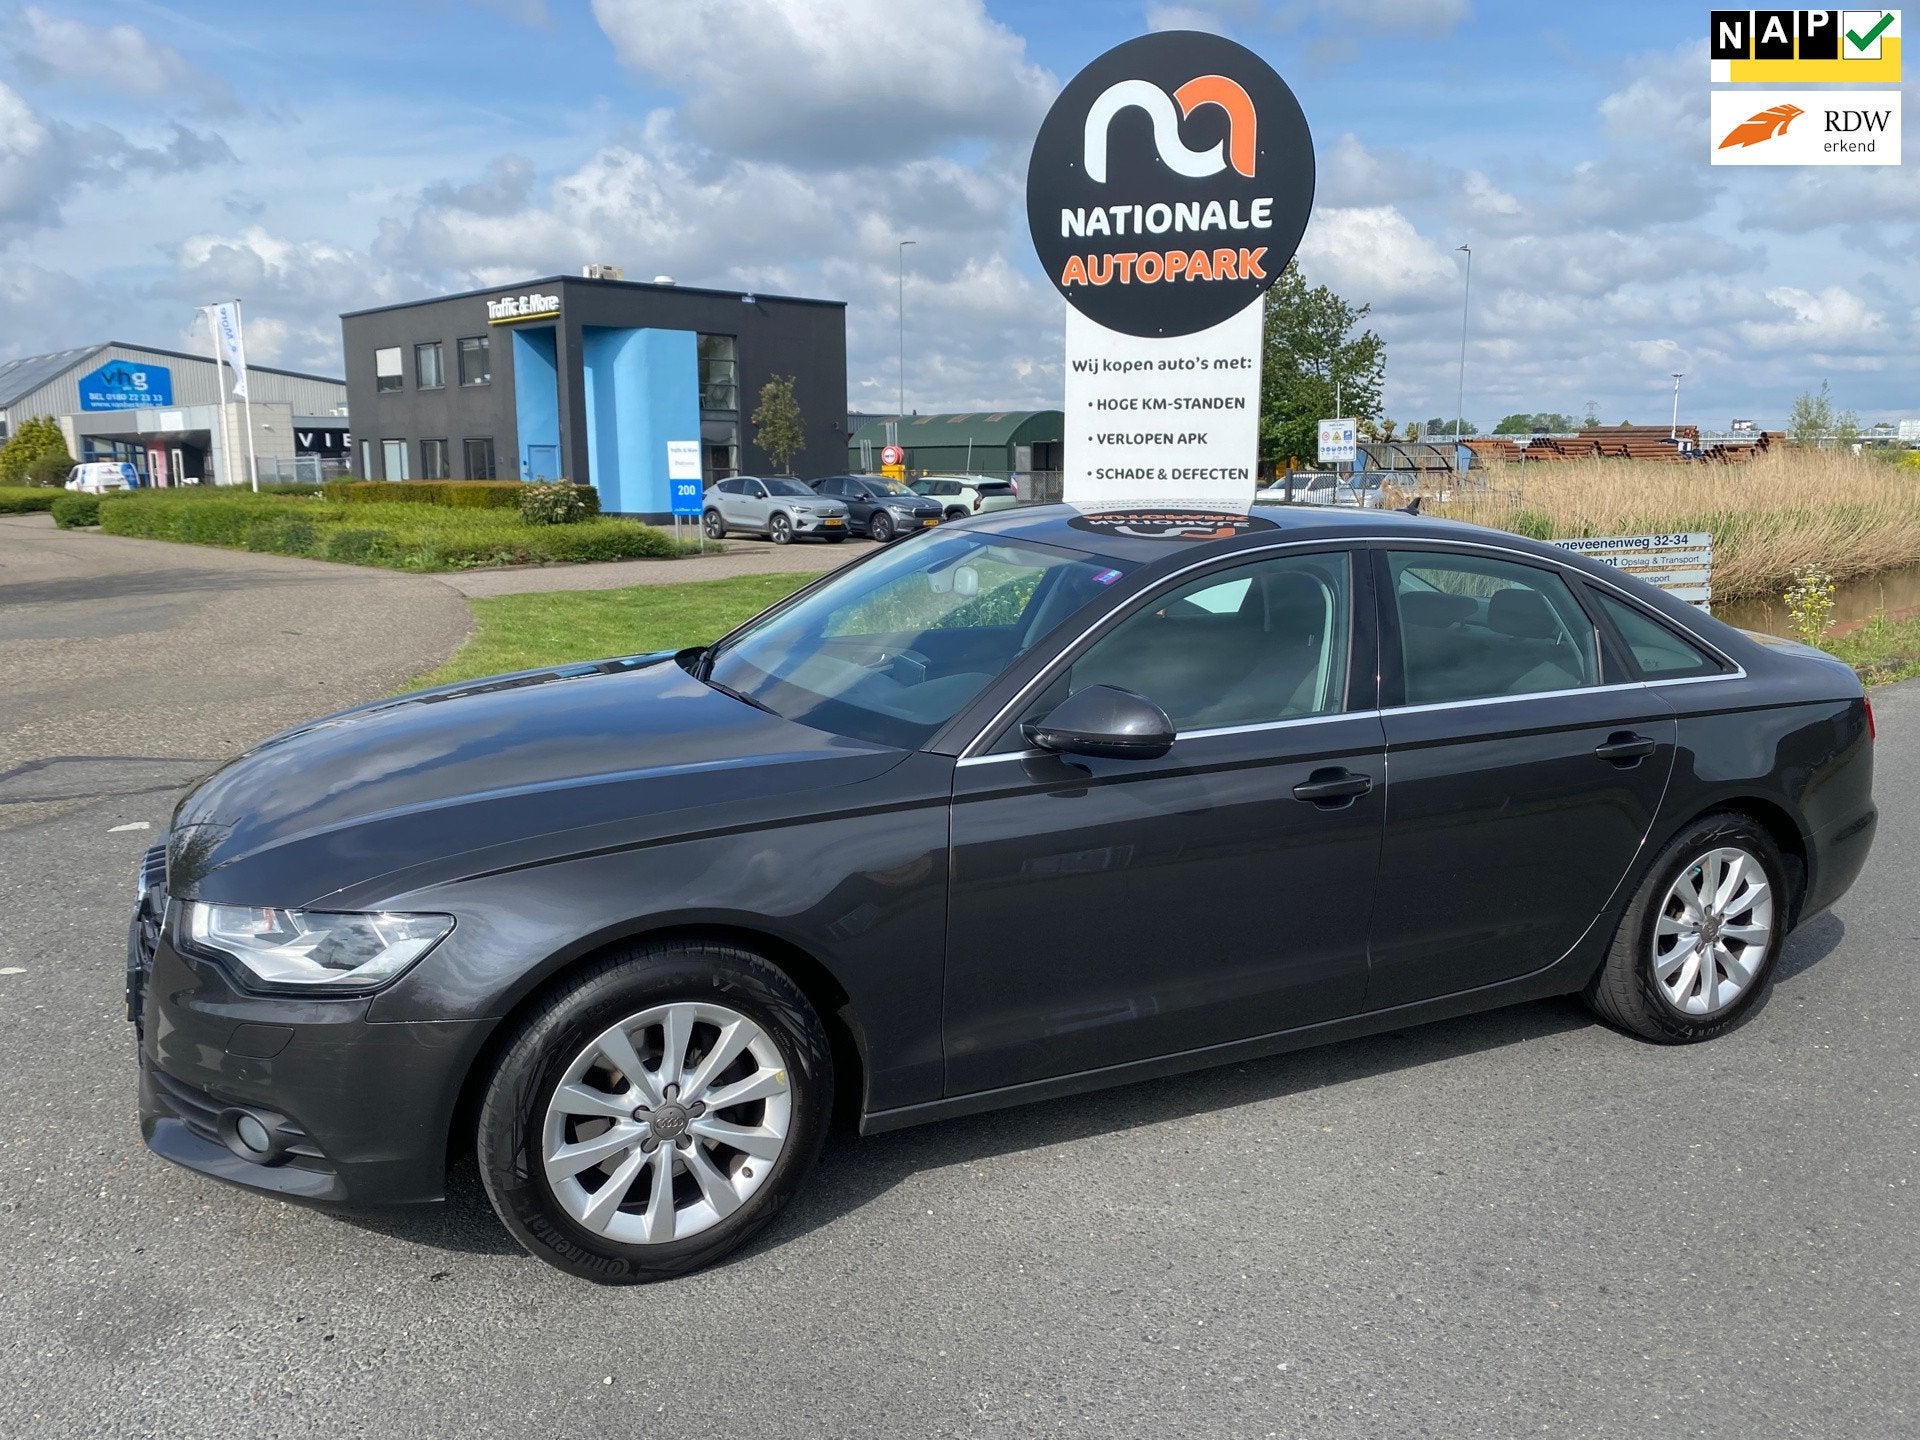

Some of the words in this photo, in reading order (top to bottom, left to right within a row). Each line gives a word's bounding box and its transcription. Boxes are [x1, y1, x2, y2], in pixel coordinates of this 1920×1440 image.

[1061, 197, 1273, 237] NATIONALE
[1062, 247, 1268, 286] AUTOPARK
[487, 297, 519, 319] Traffic
[519, 296, 529, 314] &
[530, 294, 560, 312] More
[1072, 358, 1098, 374] Wij
[1103, 358, 1153, 373] kopen
[1157, 356, 1209, 370] auto's
[1213, 356, 1252, 369] met:
[101, 368, 149, 391] vhg
[1097, 398, 1138, 410] HOGE
[1142, 397, 1245, 410] KM-STANDEN
[1096, 433, 1173, 445] VERLOPEN
[1177, 432, 1208, 444] APK
[1096, 468, 1154, 480] SCHADE
[1157, 468, 1168, 480] &
[1171, 468, 1249, 480] DEFECTEN
[677, 485, 696, 496] 200
[1654, 534, 1688, 546] 32-34
[1621, 557, 1650, 567] Opslag
[1661, 556, 1699, 565] Transport
